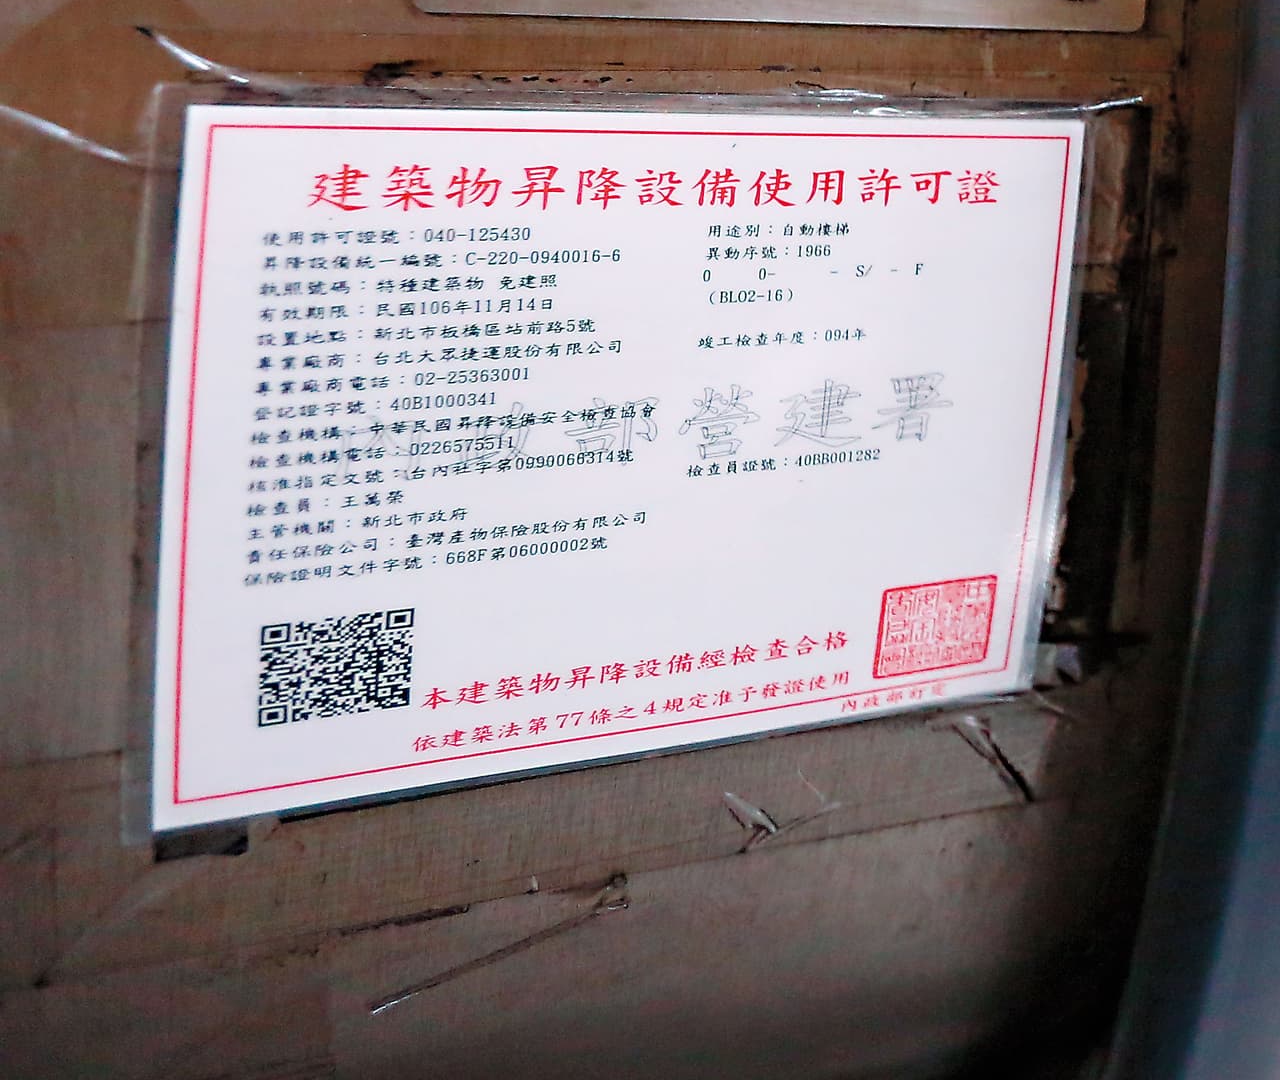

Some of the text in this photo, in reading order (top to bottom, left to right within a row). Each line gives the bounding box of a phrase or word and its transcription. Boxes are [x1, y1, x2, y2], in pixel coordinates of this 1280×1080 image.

[306, 164, 1000, 210] 建築物昇降設備使用許可證
[420, 630, 849, 710] 本建築物昇降設備經檢查合格
